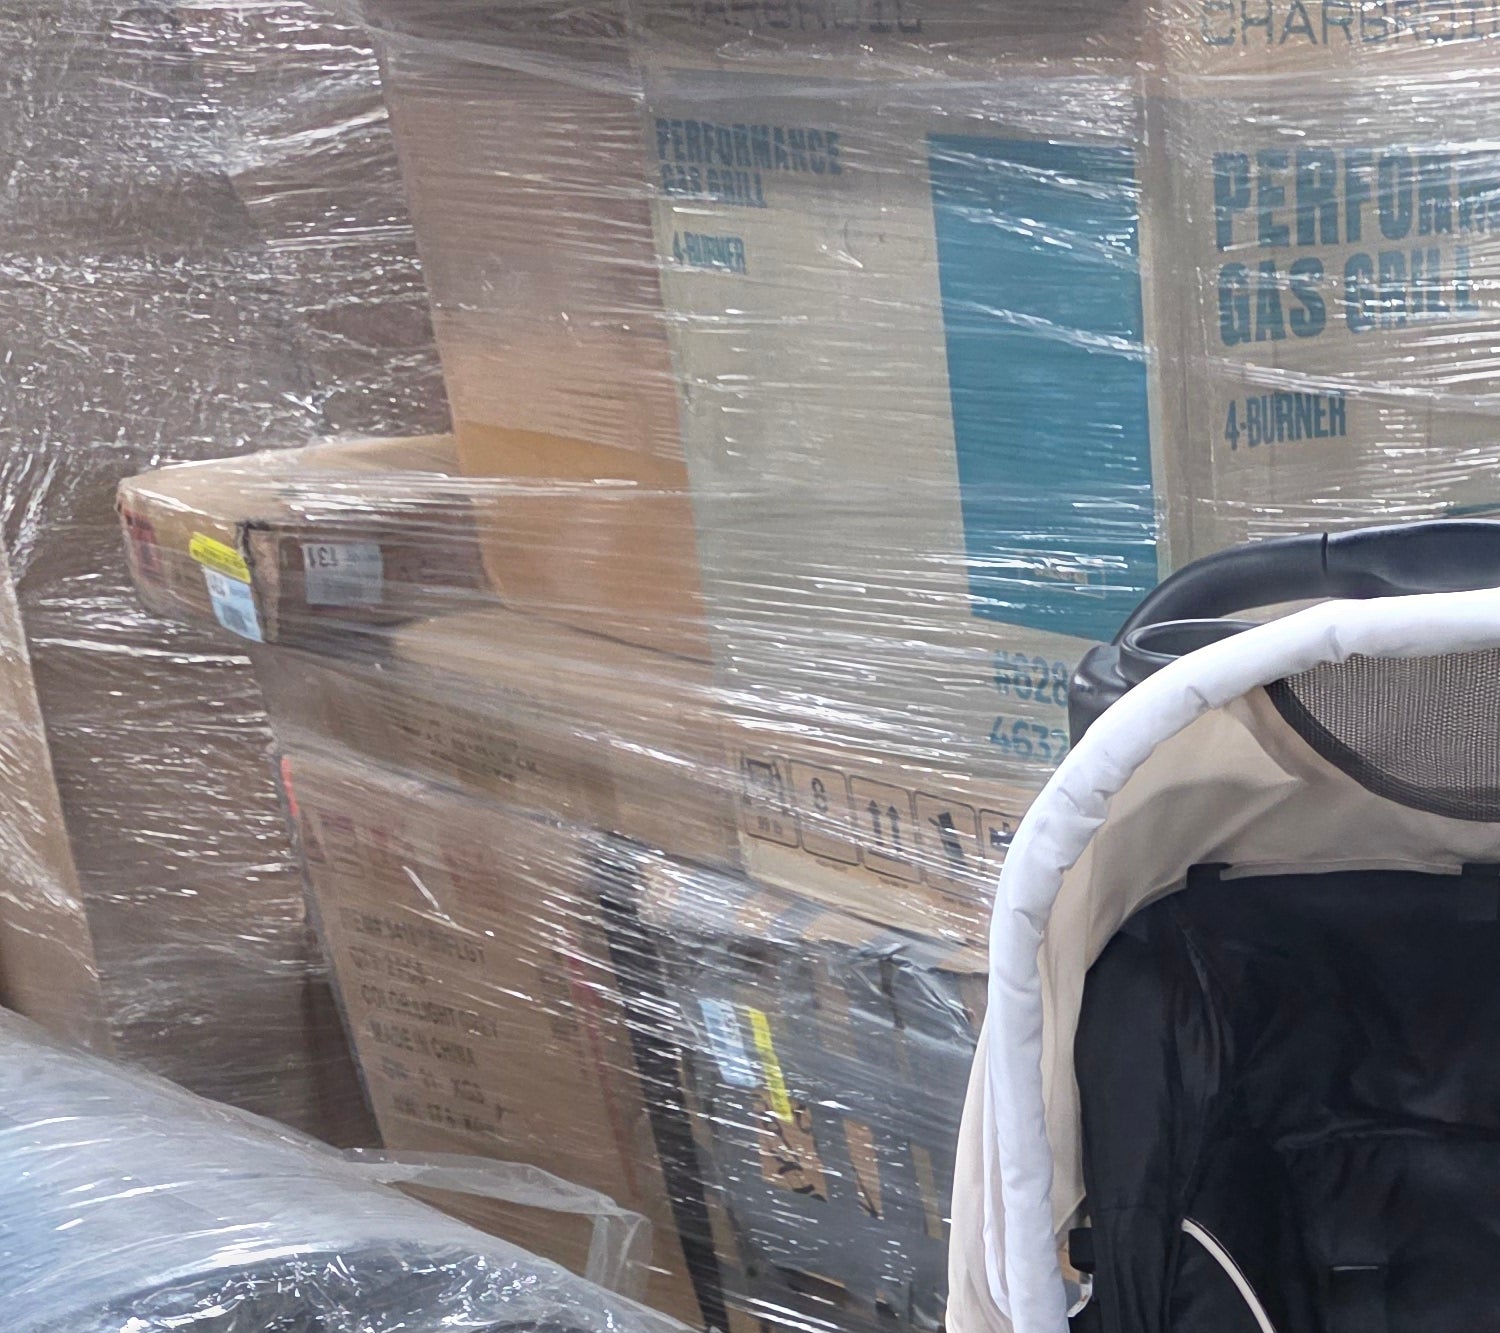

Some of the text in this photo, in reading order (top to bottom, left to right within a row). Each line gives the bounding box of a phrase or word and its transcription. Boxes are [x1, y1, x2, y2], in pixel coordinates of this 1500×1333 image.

[655, 117, 842, 176] PERFORMANCE
[1218, 256, 1328, 347] GAS
[1223, 390, 1349, 452] 4-BURNER
